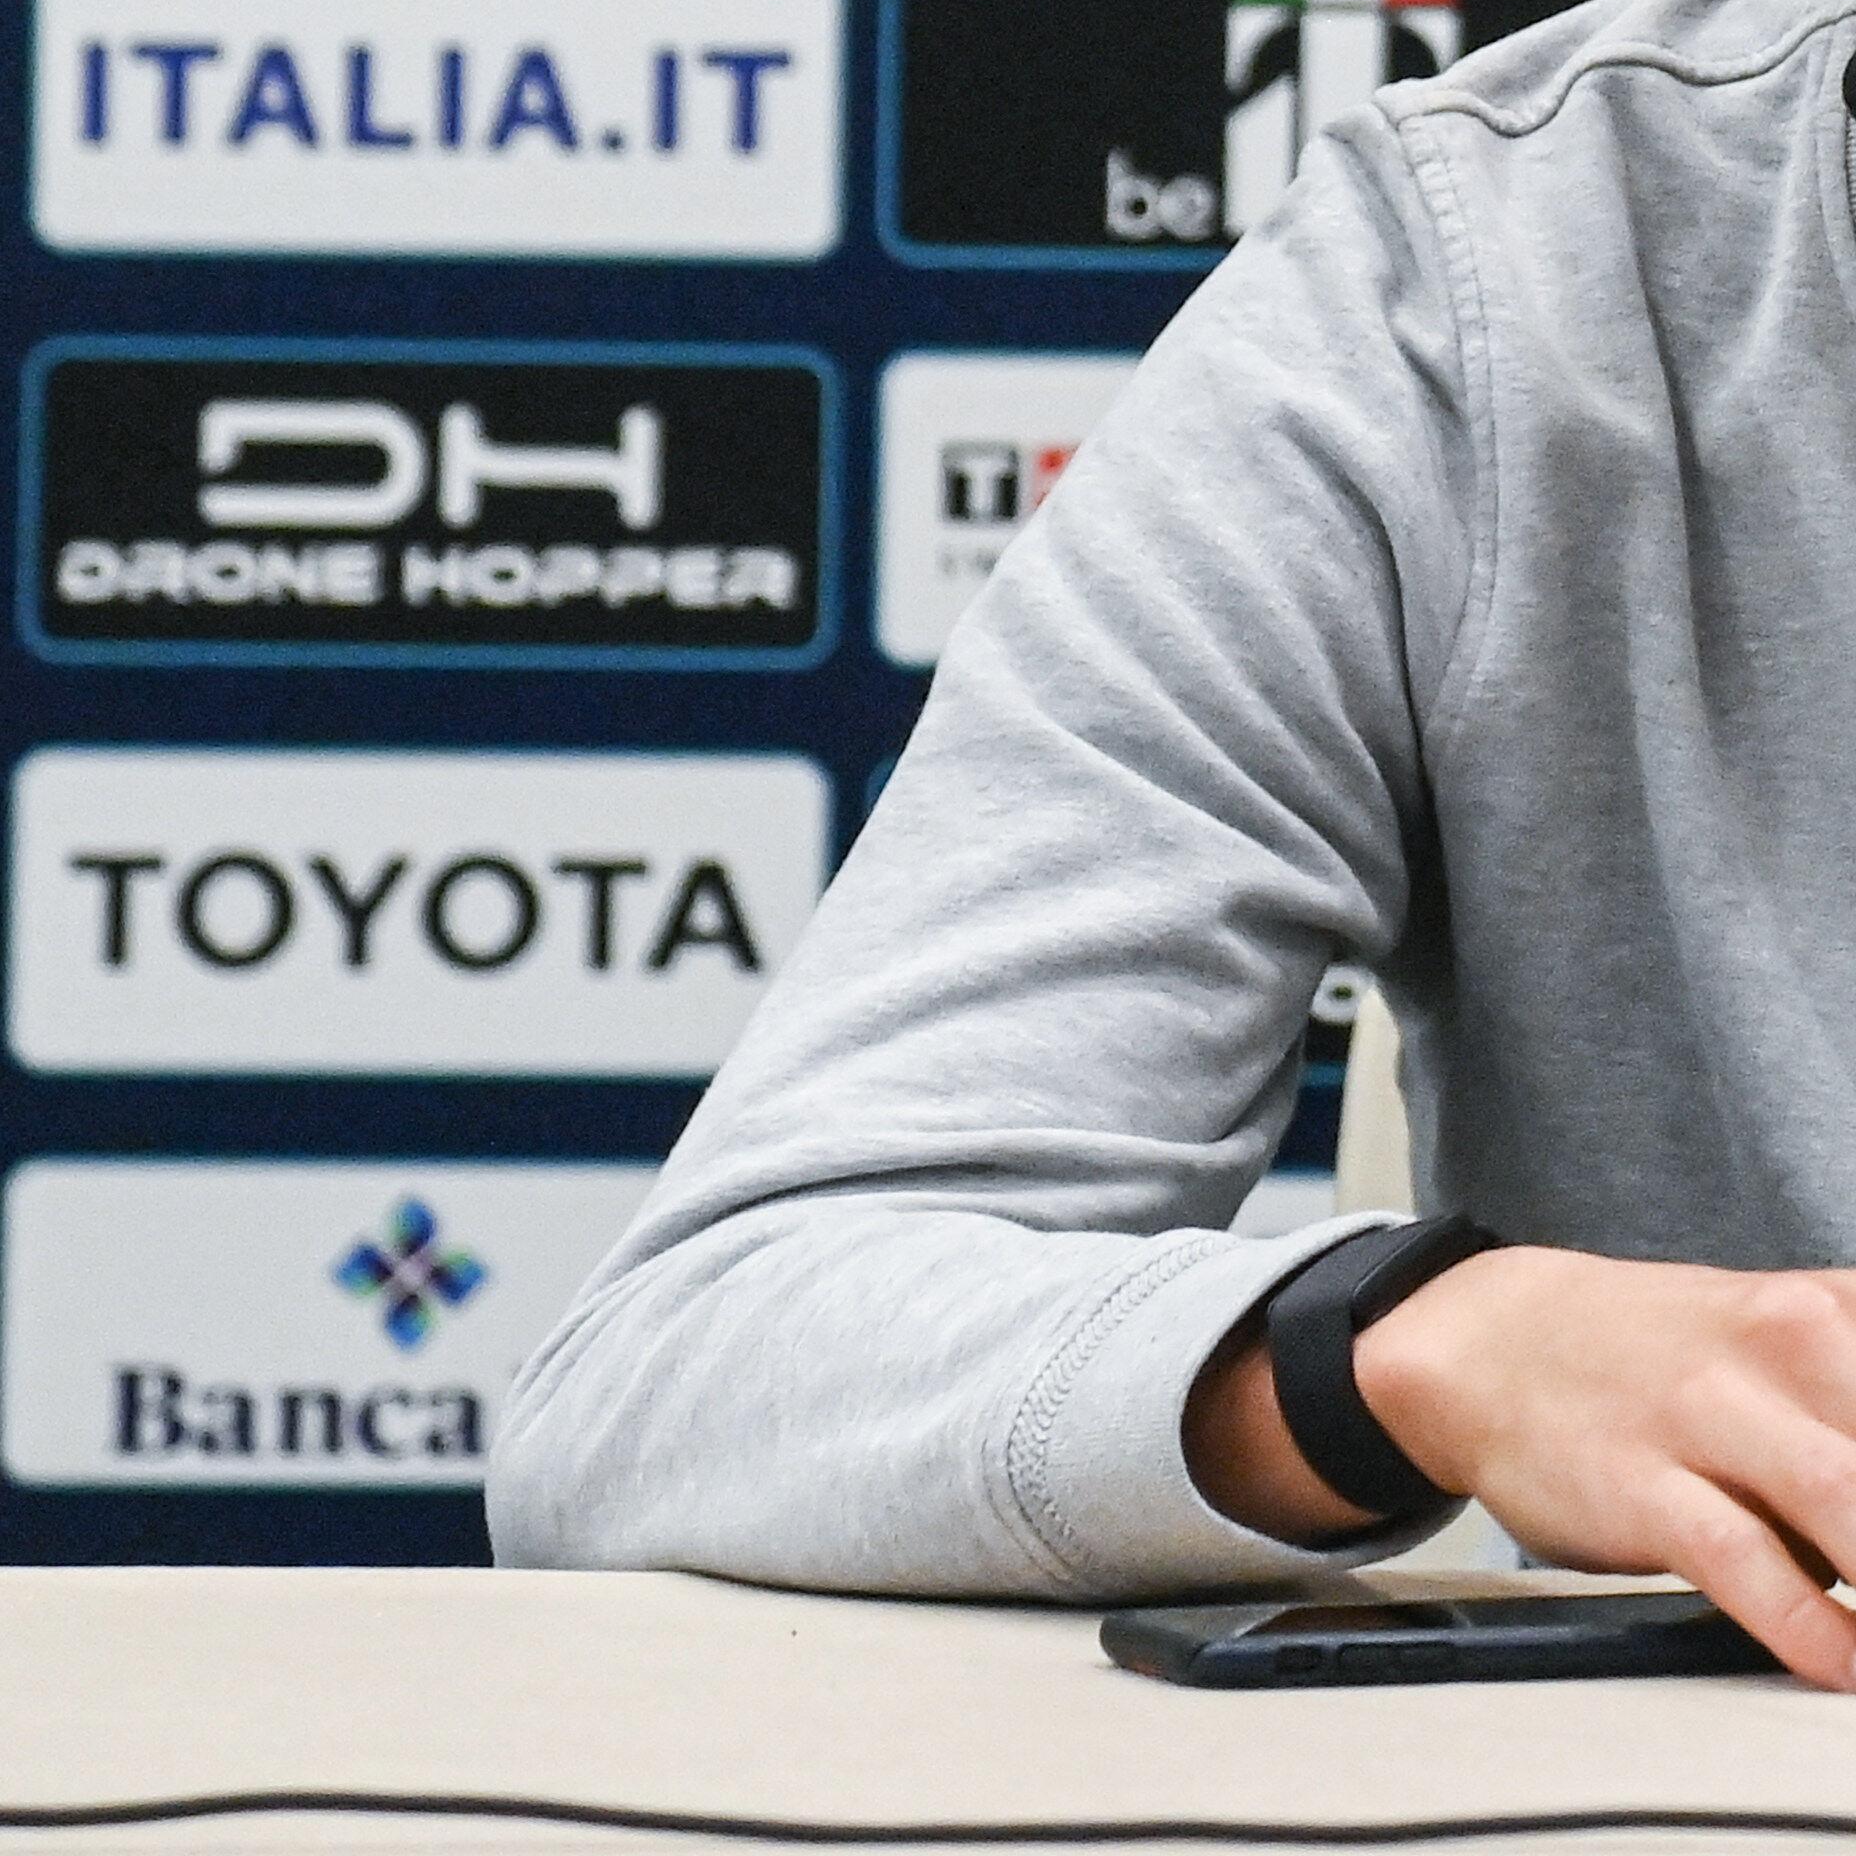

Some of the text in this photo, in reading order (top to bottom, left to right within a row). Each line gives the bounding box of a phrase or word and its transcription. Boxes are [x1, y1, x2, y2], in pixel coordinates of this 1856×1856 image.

[80, 39, 793, 156] ITALIA.IT
[58, 540, 797, 609] DRONE HOPPER
[70, 851, 763, 974] TOYOTA
[109, 1364, 486, 1458] Banca
